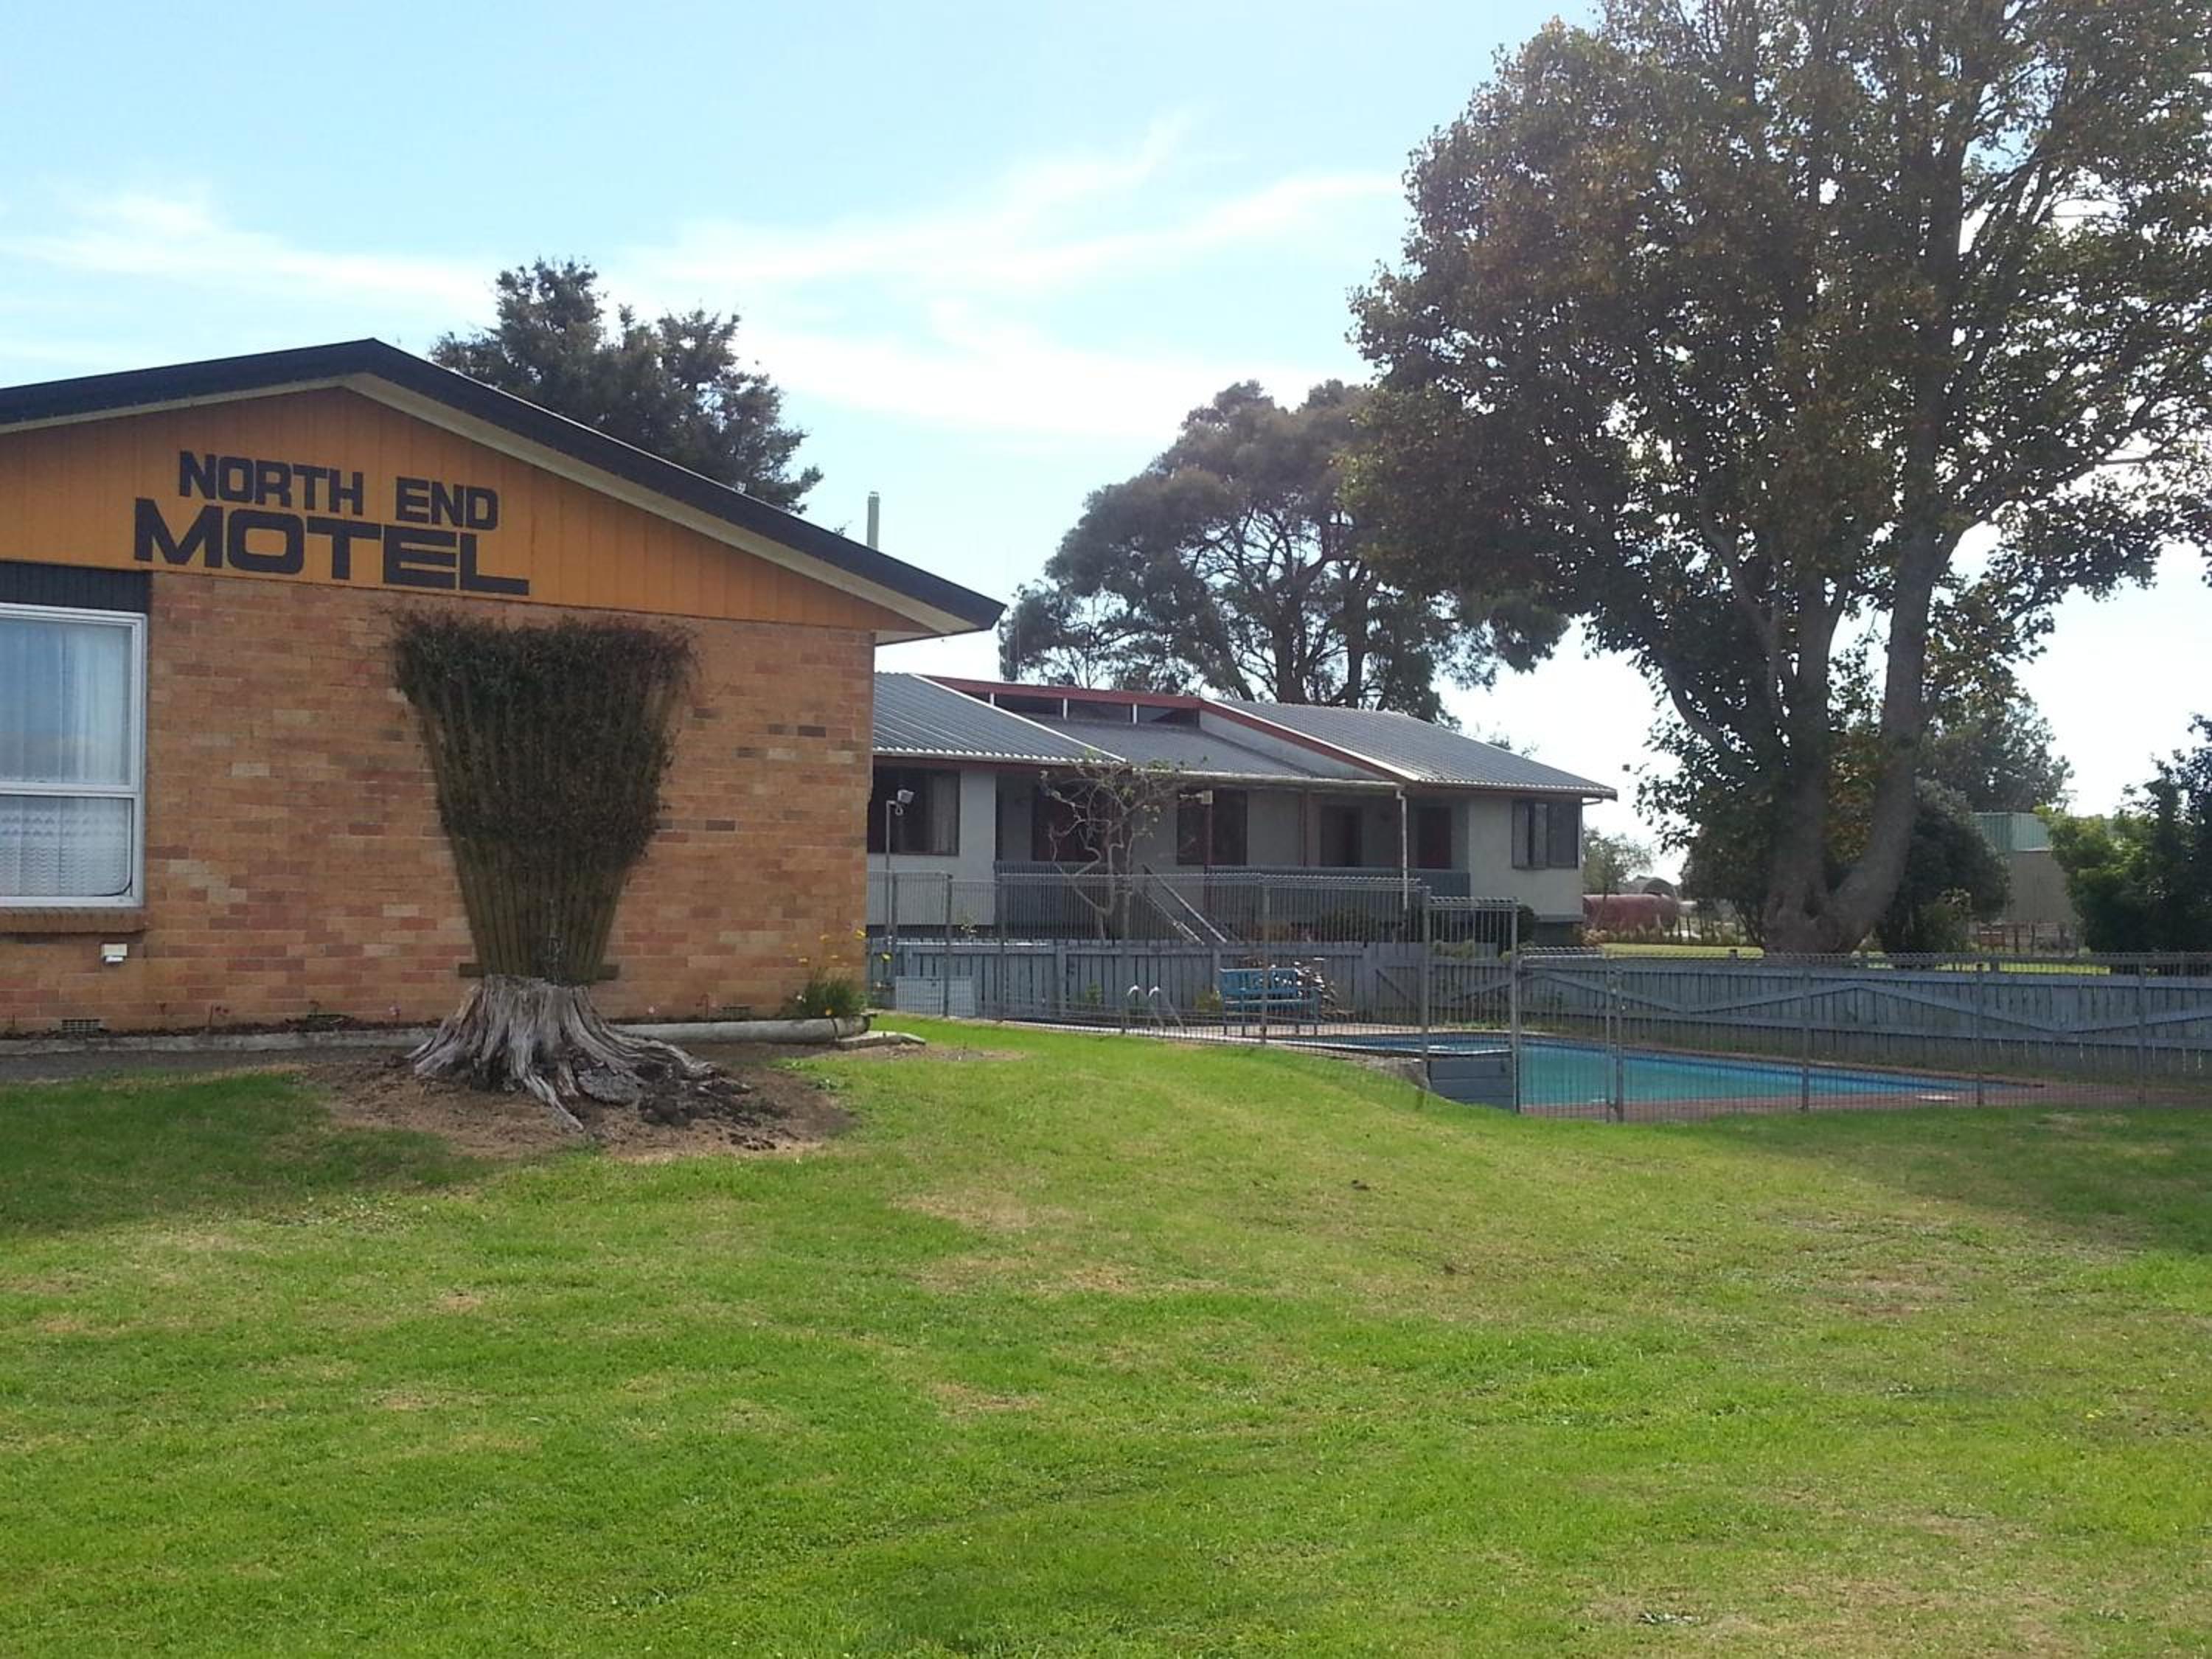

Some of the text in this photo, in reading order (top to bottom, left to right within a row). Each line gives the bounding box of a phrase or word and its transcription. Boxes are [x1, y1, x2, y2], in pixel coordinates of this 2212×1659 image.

[179, 451, 498, 531] NORTH END
[134, 498, 529, 596] MOTEL
